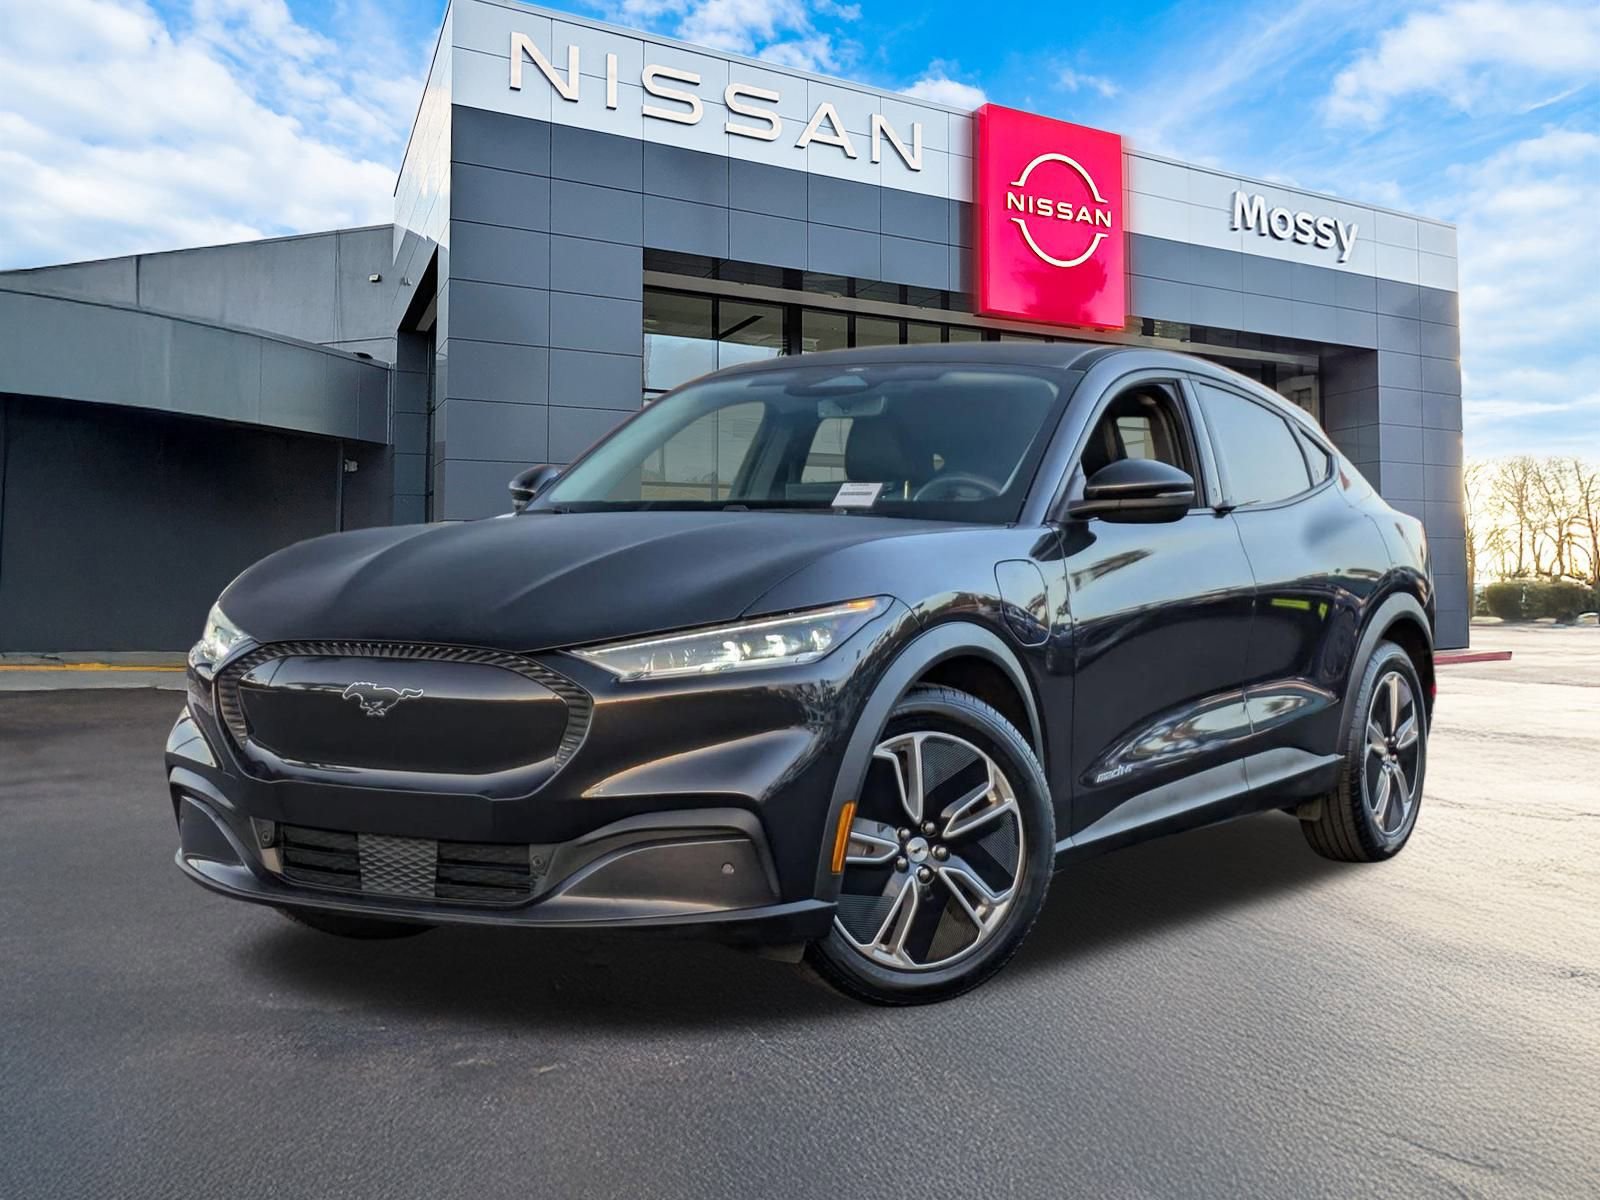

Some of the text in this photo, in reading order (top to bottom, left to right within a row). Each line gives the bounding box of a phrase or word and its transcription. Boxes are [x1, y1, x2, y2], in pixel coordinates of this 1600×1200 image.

[509, 31, 922, 171] NISSAN
[1007, 191, 1112, 227] NISSAN
[1230, 190, 1359, 262] Mossy
